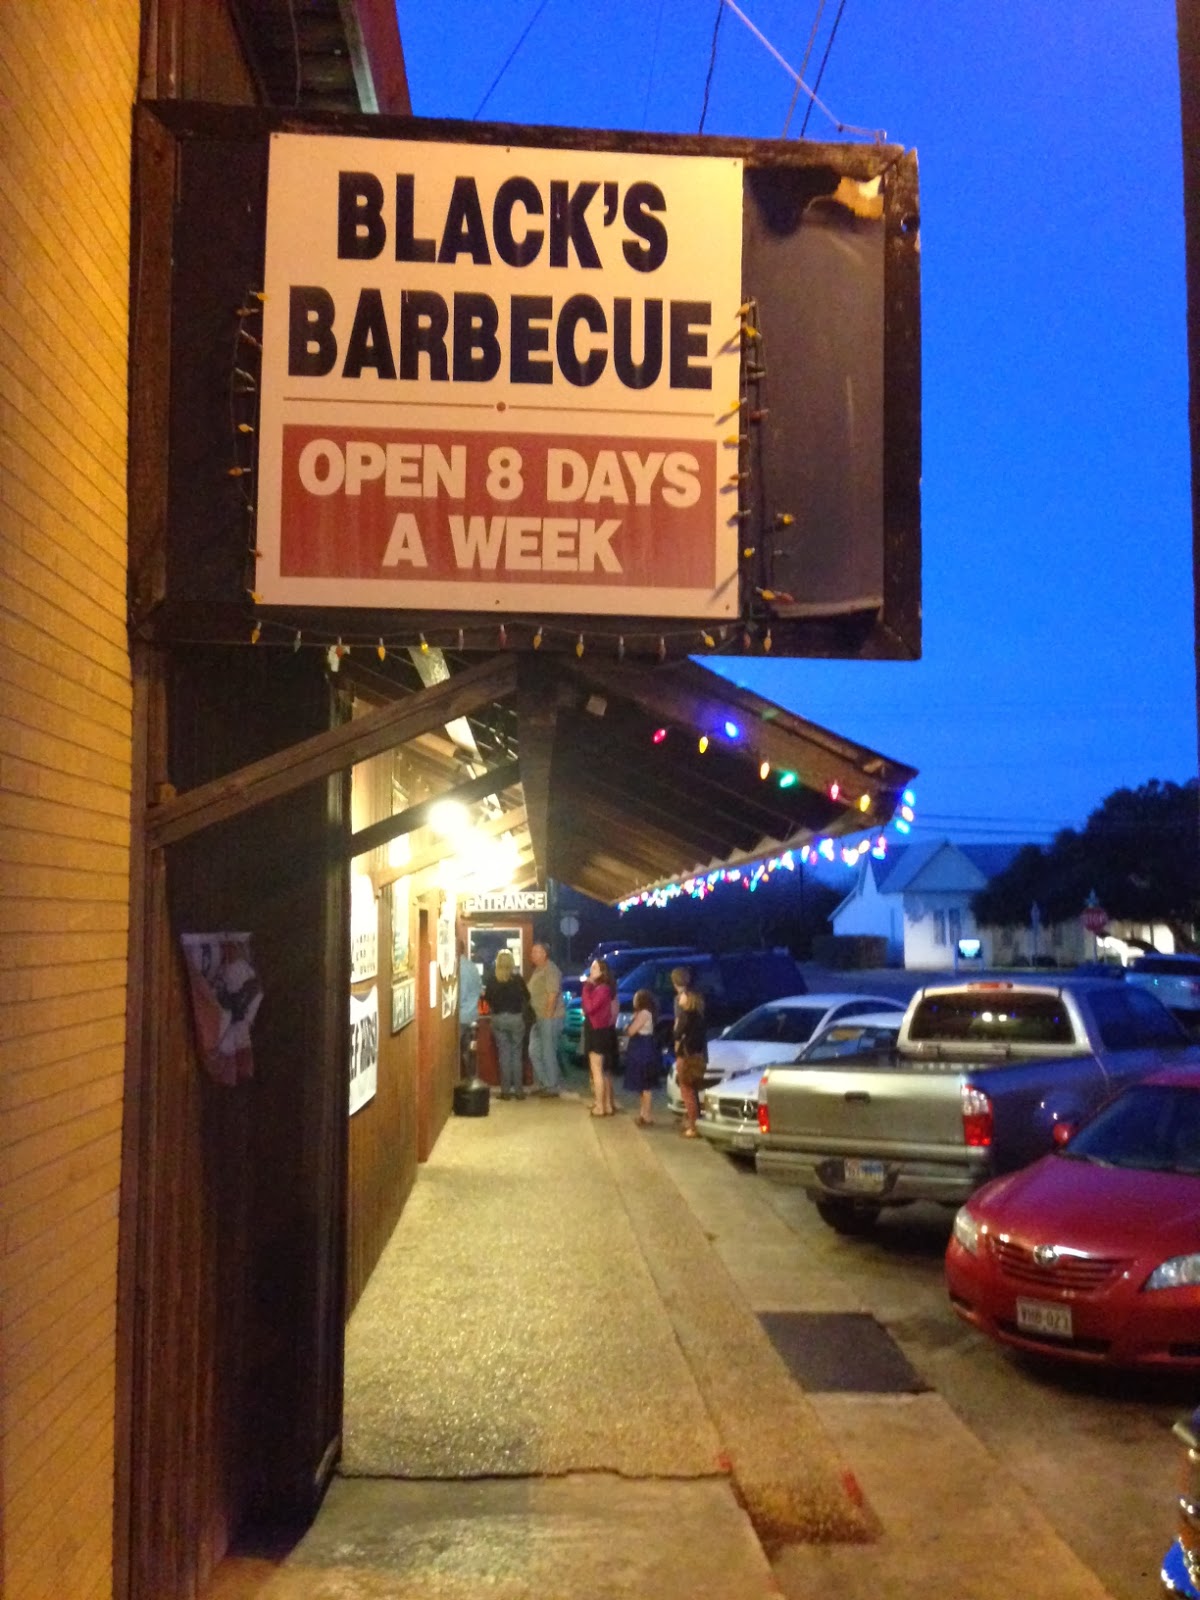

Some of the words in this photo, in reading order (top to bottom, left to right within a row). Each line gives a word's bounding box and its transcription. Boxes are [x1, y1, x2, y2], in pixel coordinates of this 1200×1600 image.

[337, 171, 669, 272] BLACK'S
[288, 285, 713, 390] BARBECUE
[299, 438, 467, 499] OPEN
[486, 447, 524, 502] 8
[546, 448, 701, 508] DAYS
[382, 513, 428, 568] A
[448, 514, 623, 574] WEEK
[466, 893, 544, 909] ENTRANCE
